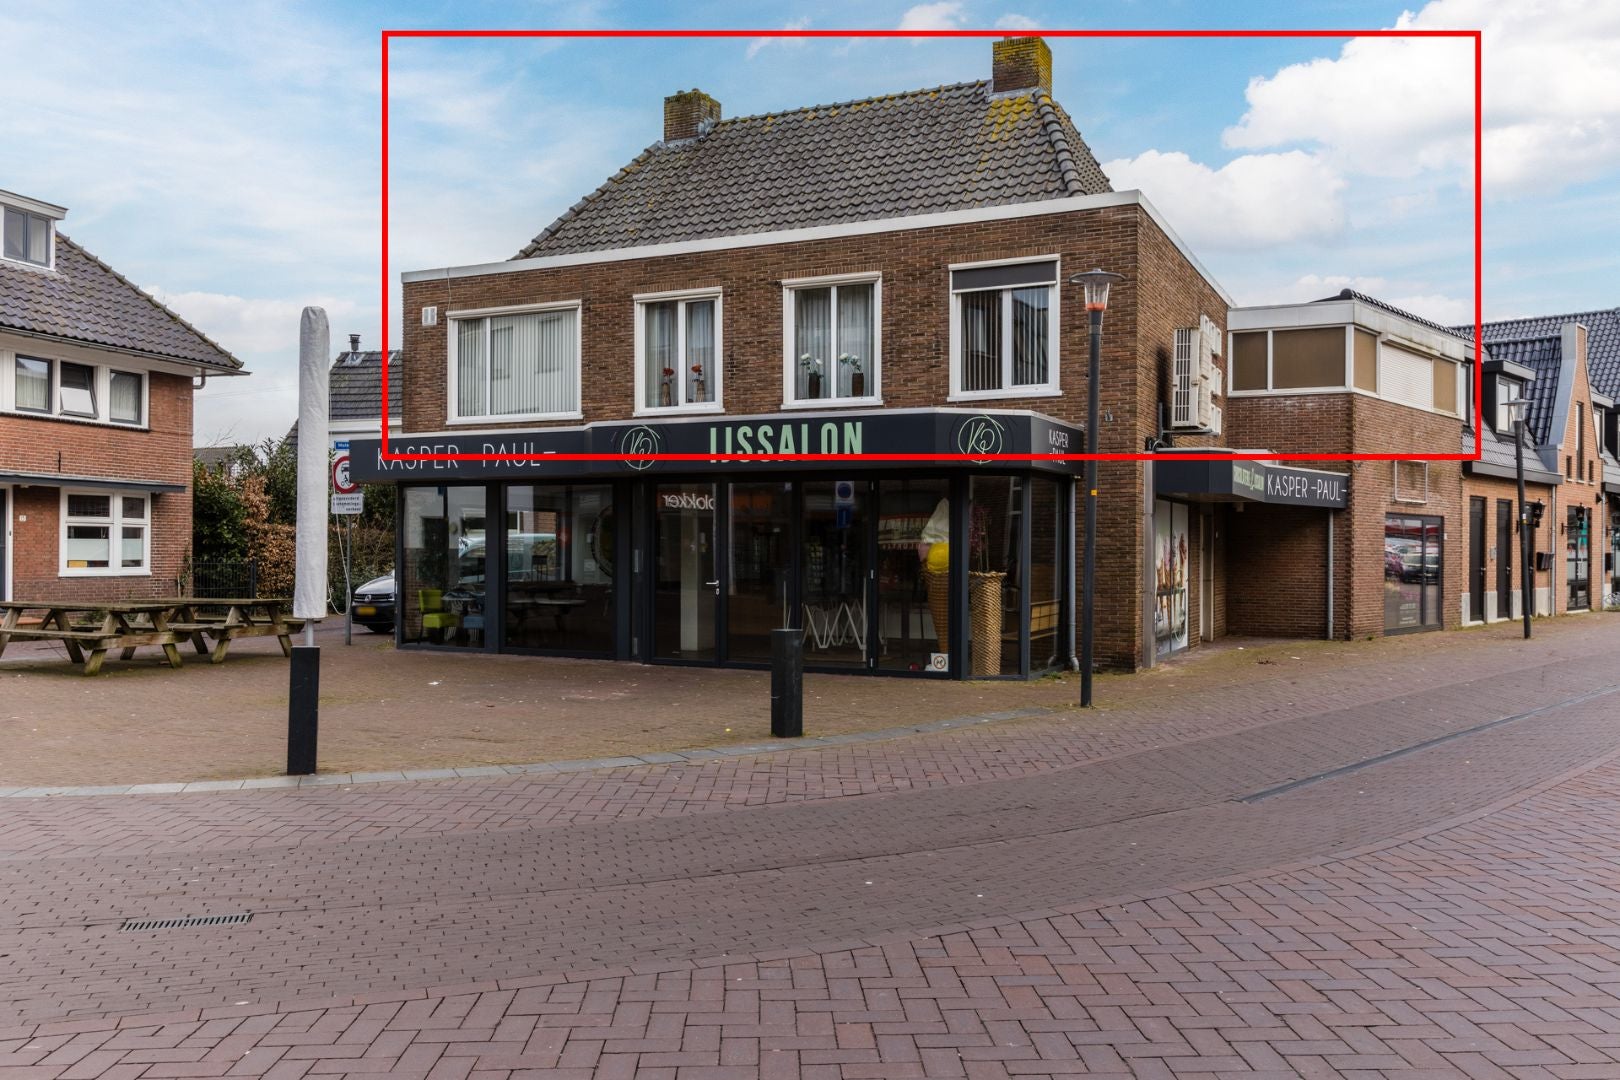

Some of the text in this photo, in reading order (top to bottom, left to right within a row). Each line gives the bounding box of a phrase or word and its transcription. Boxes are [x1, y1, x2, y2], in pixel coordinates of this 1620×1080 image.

[709, 421, 863, 463] IJSSALON
[1048, 429, 1069, 448] KASPER
[377, 444, 459, 471] KASPER
